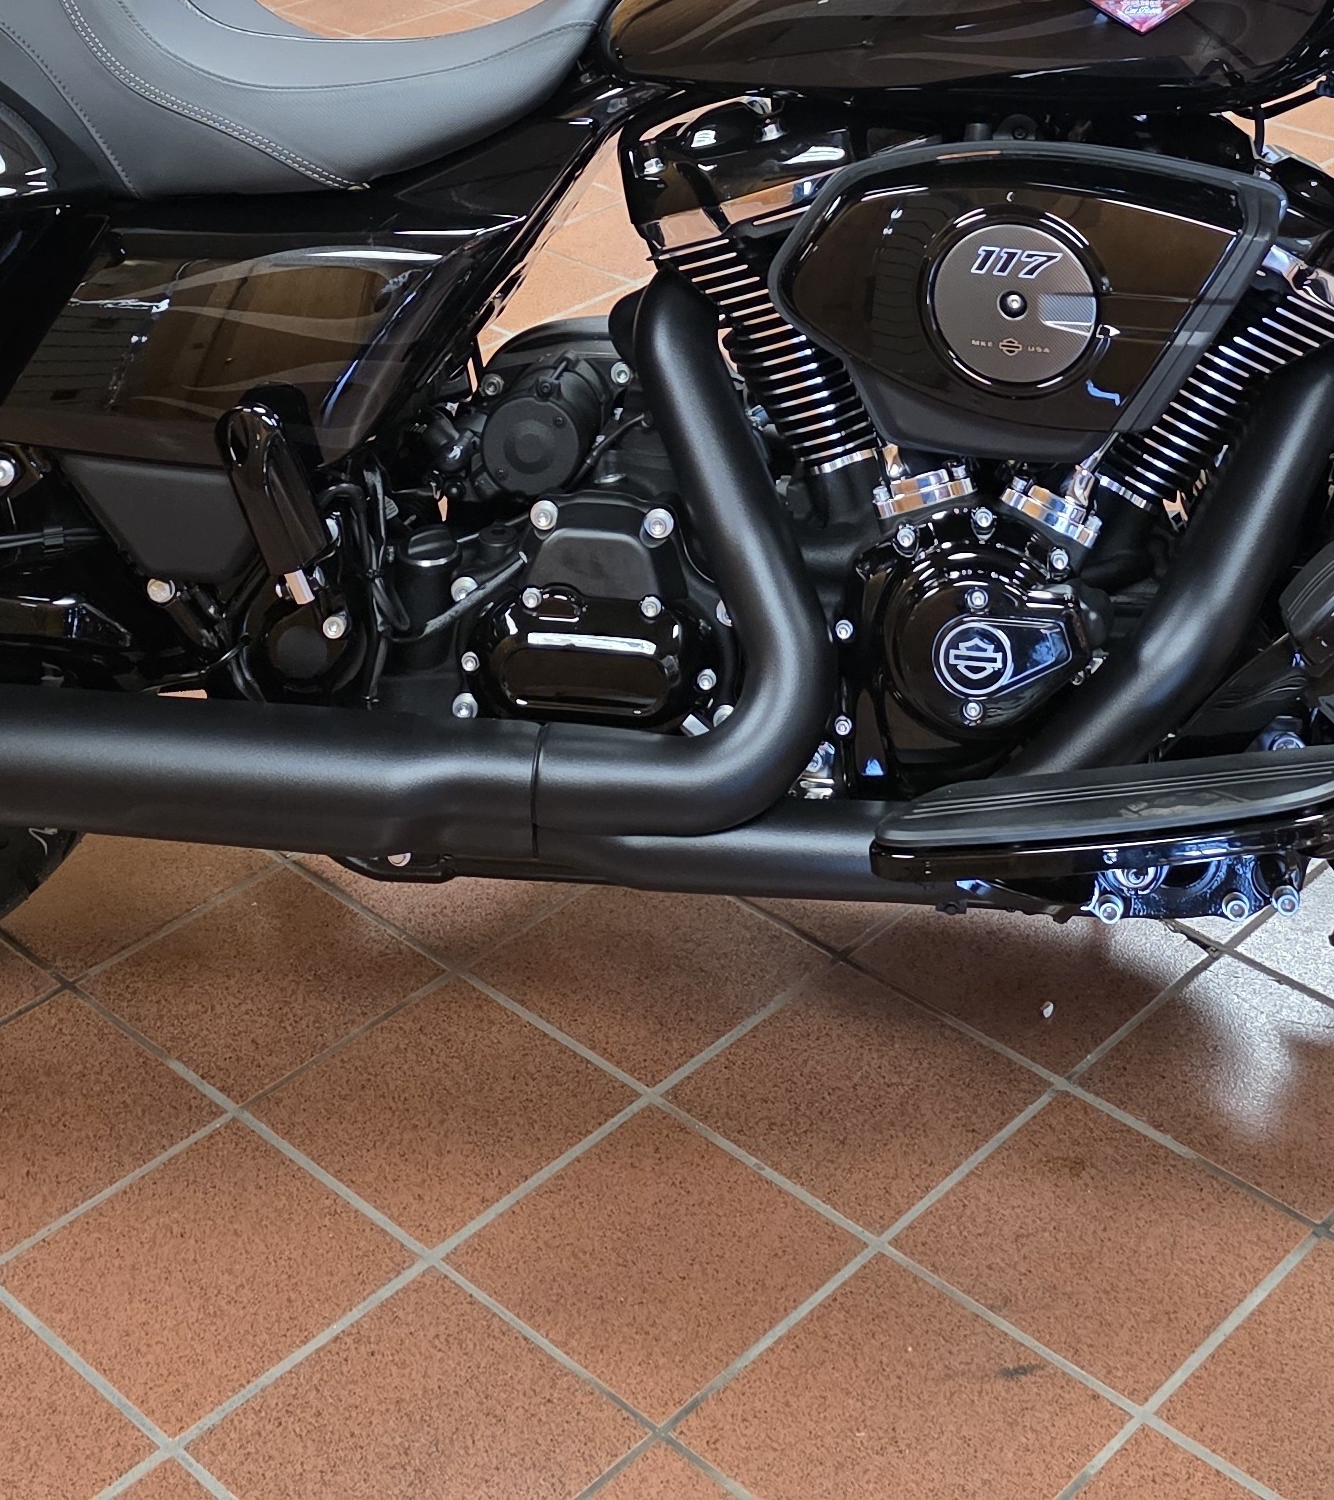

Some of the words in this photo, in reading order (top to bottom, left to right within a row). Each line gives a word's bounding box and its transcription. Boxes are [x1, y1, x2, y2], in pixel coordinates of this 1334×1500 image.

[970, 245, 1063, 279] 117
[971, 339, 993, 348] MKE
[1027, 345, 1050, 354] USA
